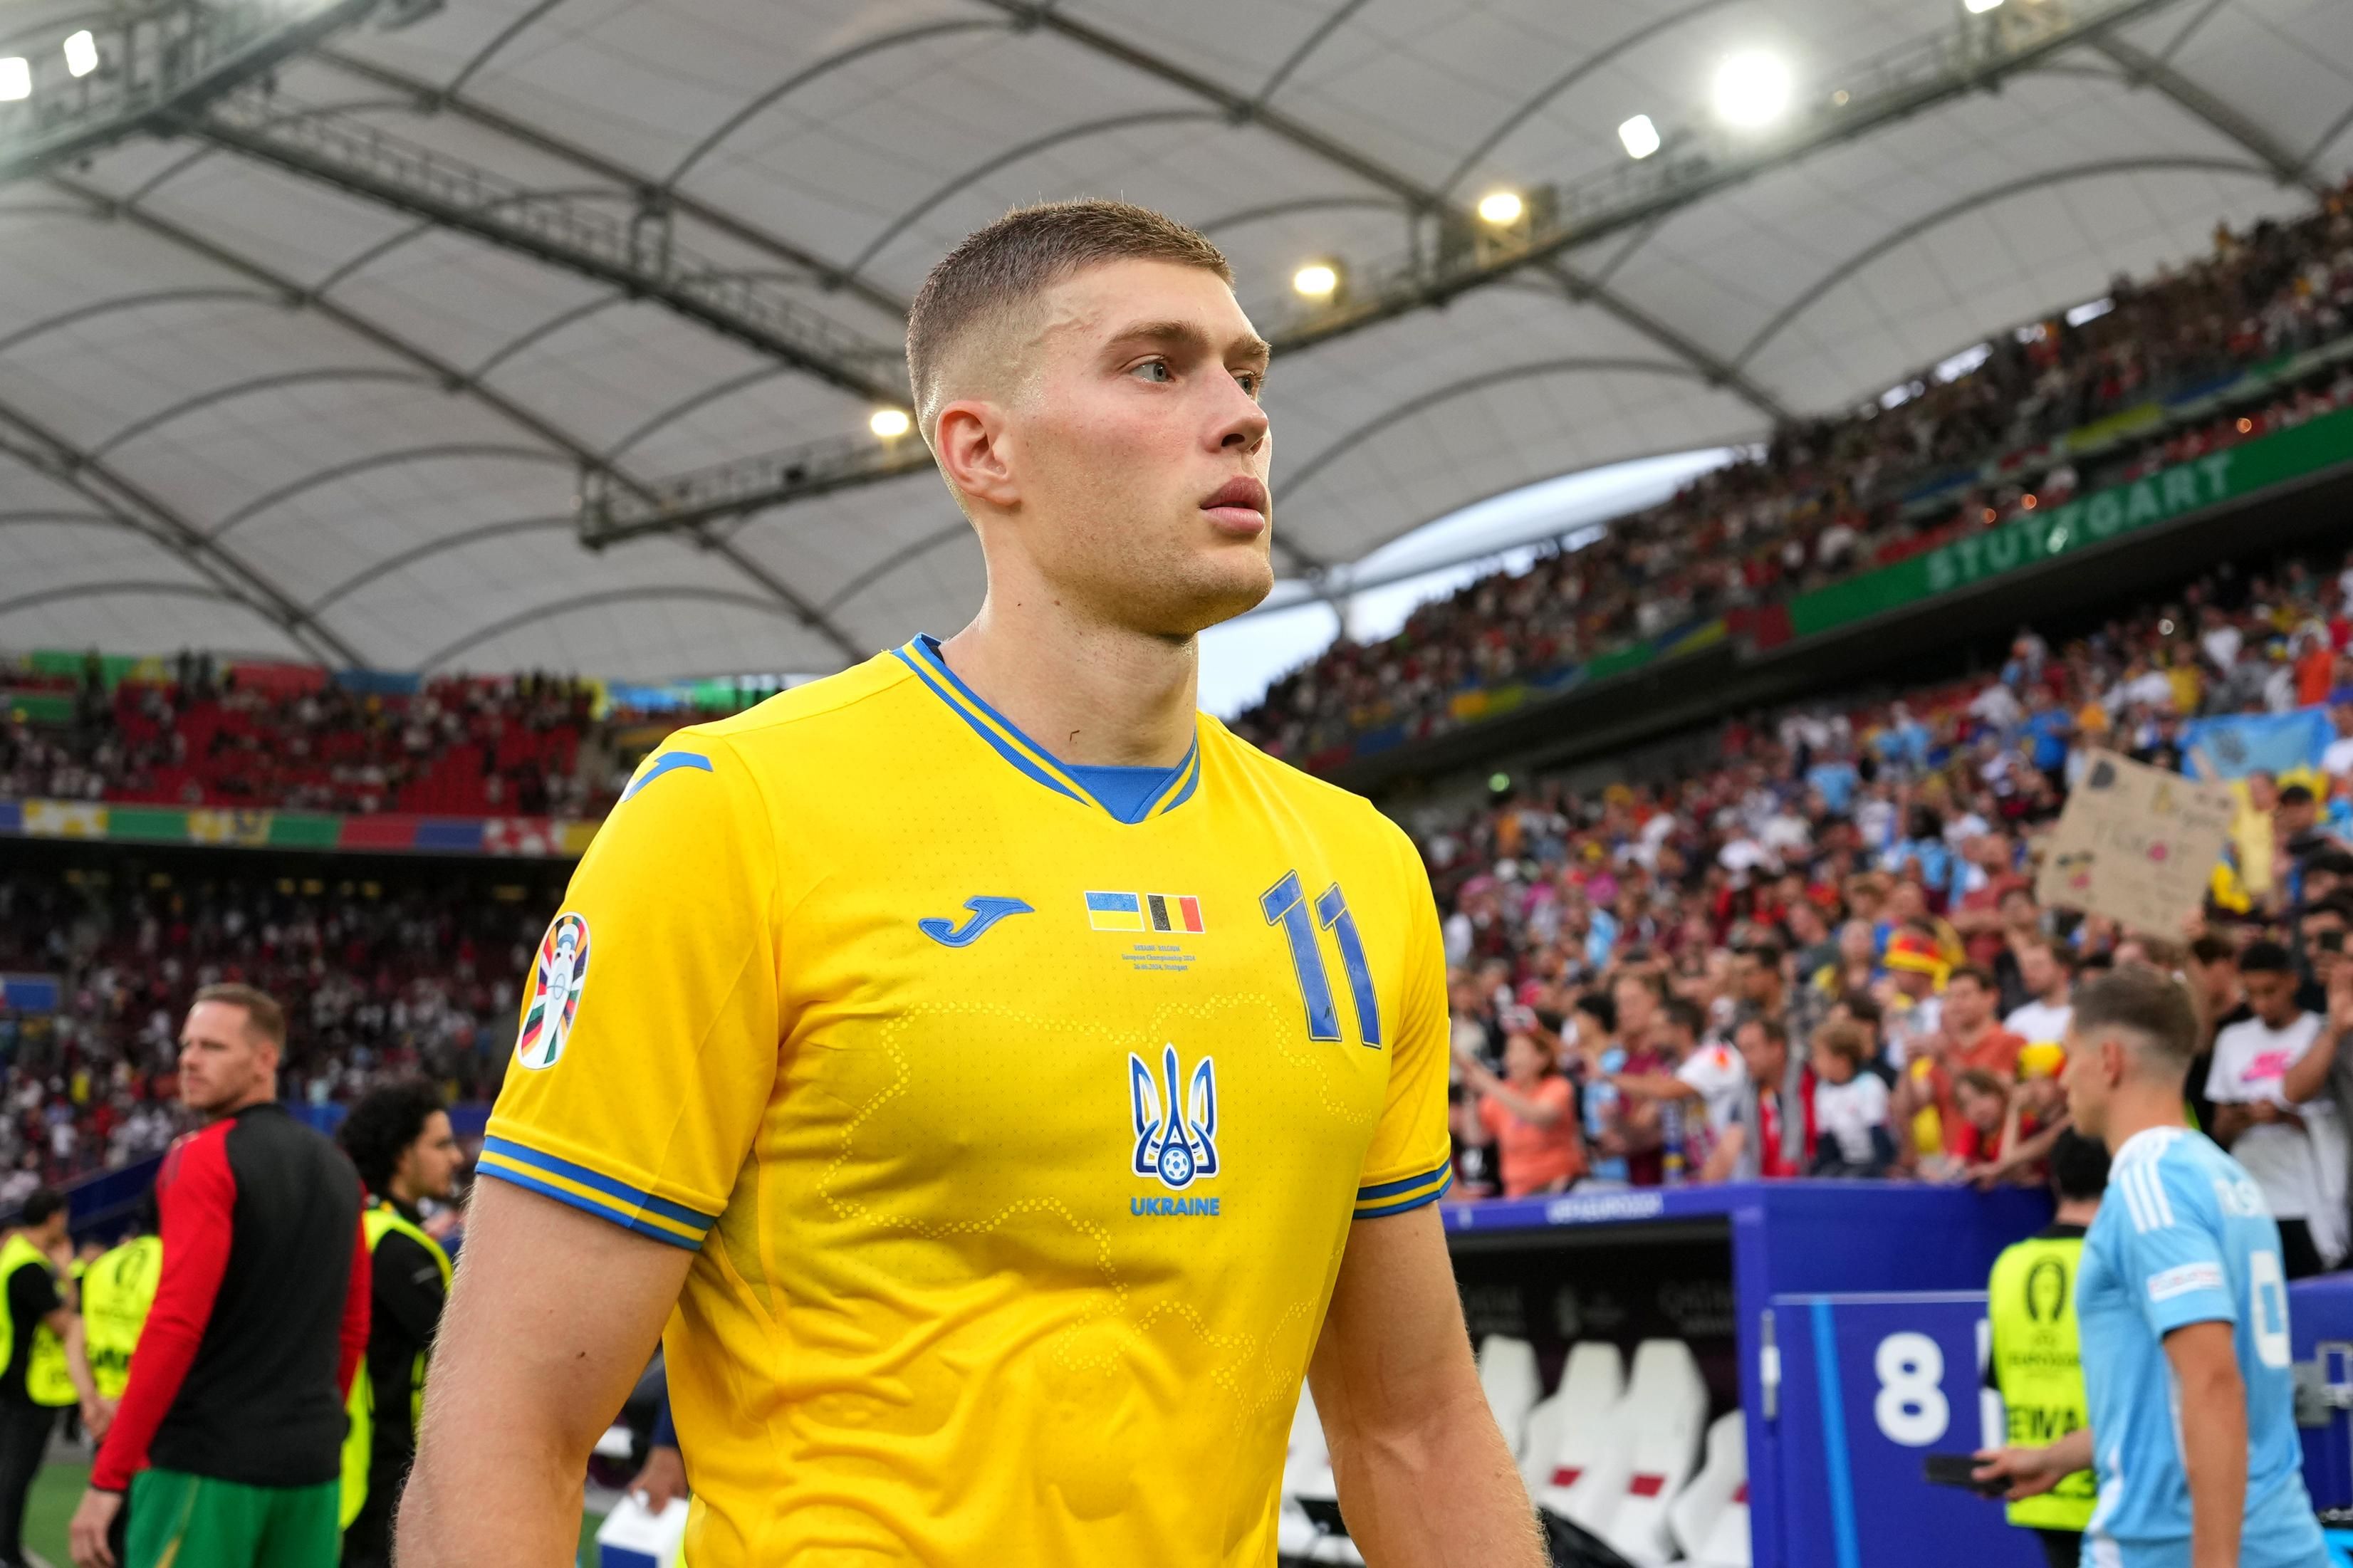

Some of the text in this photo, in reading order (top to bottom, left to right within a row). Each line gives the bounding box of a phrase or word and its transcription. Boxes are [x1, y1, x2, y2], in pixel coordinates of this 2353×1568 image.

[1258, 869, 1382, 1050] 11
[1130, 1198, 1220, 1216] UKRAINE
[1874, 1332, 1950, 1448] 8
